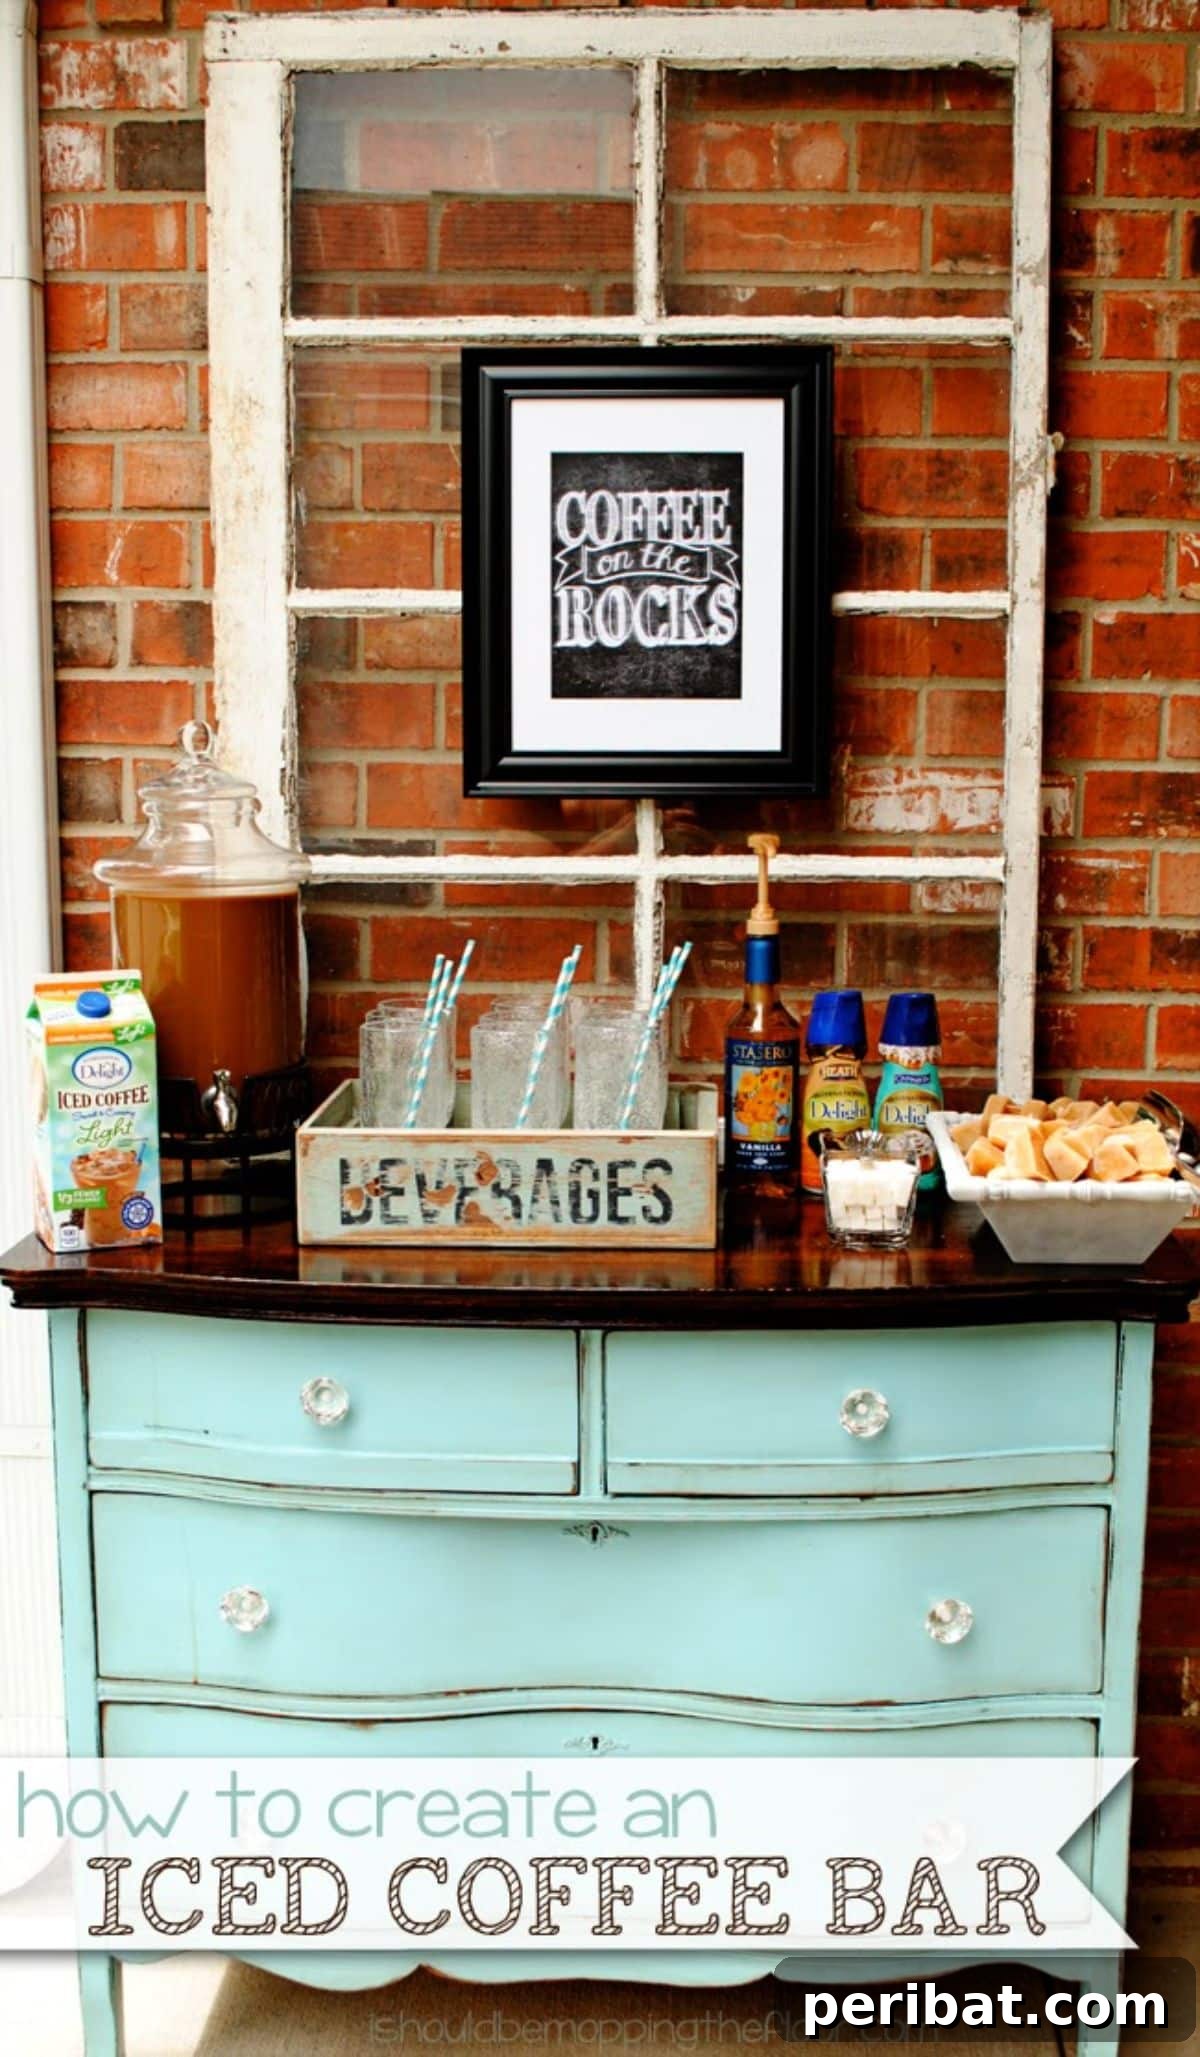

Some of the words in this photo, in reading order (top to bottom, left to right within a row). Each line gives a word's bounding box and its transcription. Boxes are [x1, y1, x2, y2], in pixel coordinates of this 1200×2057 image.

[556, 489, 732, 547] COFFEE
[597, 551, 634, 576] on
[639, 543, 692, 575] the
[554, 584, 738, 648] ROCKS
[80, 1061, 125, 1080] Delight
[57, 1090, 92, 1110] ICED
[95, 1083, 149, 1107] COFFEE
[811, 1101, 868, 1120] Delight
[885, 1104, 932, 1125] Delig
[76, 1117, 133, 1149] Light
[740, 1142, 782, 1151] VANILLA
[339, 1157, 675, 1228] BEVERAGES
